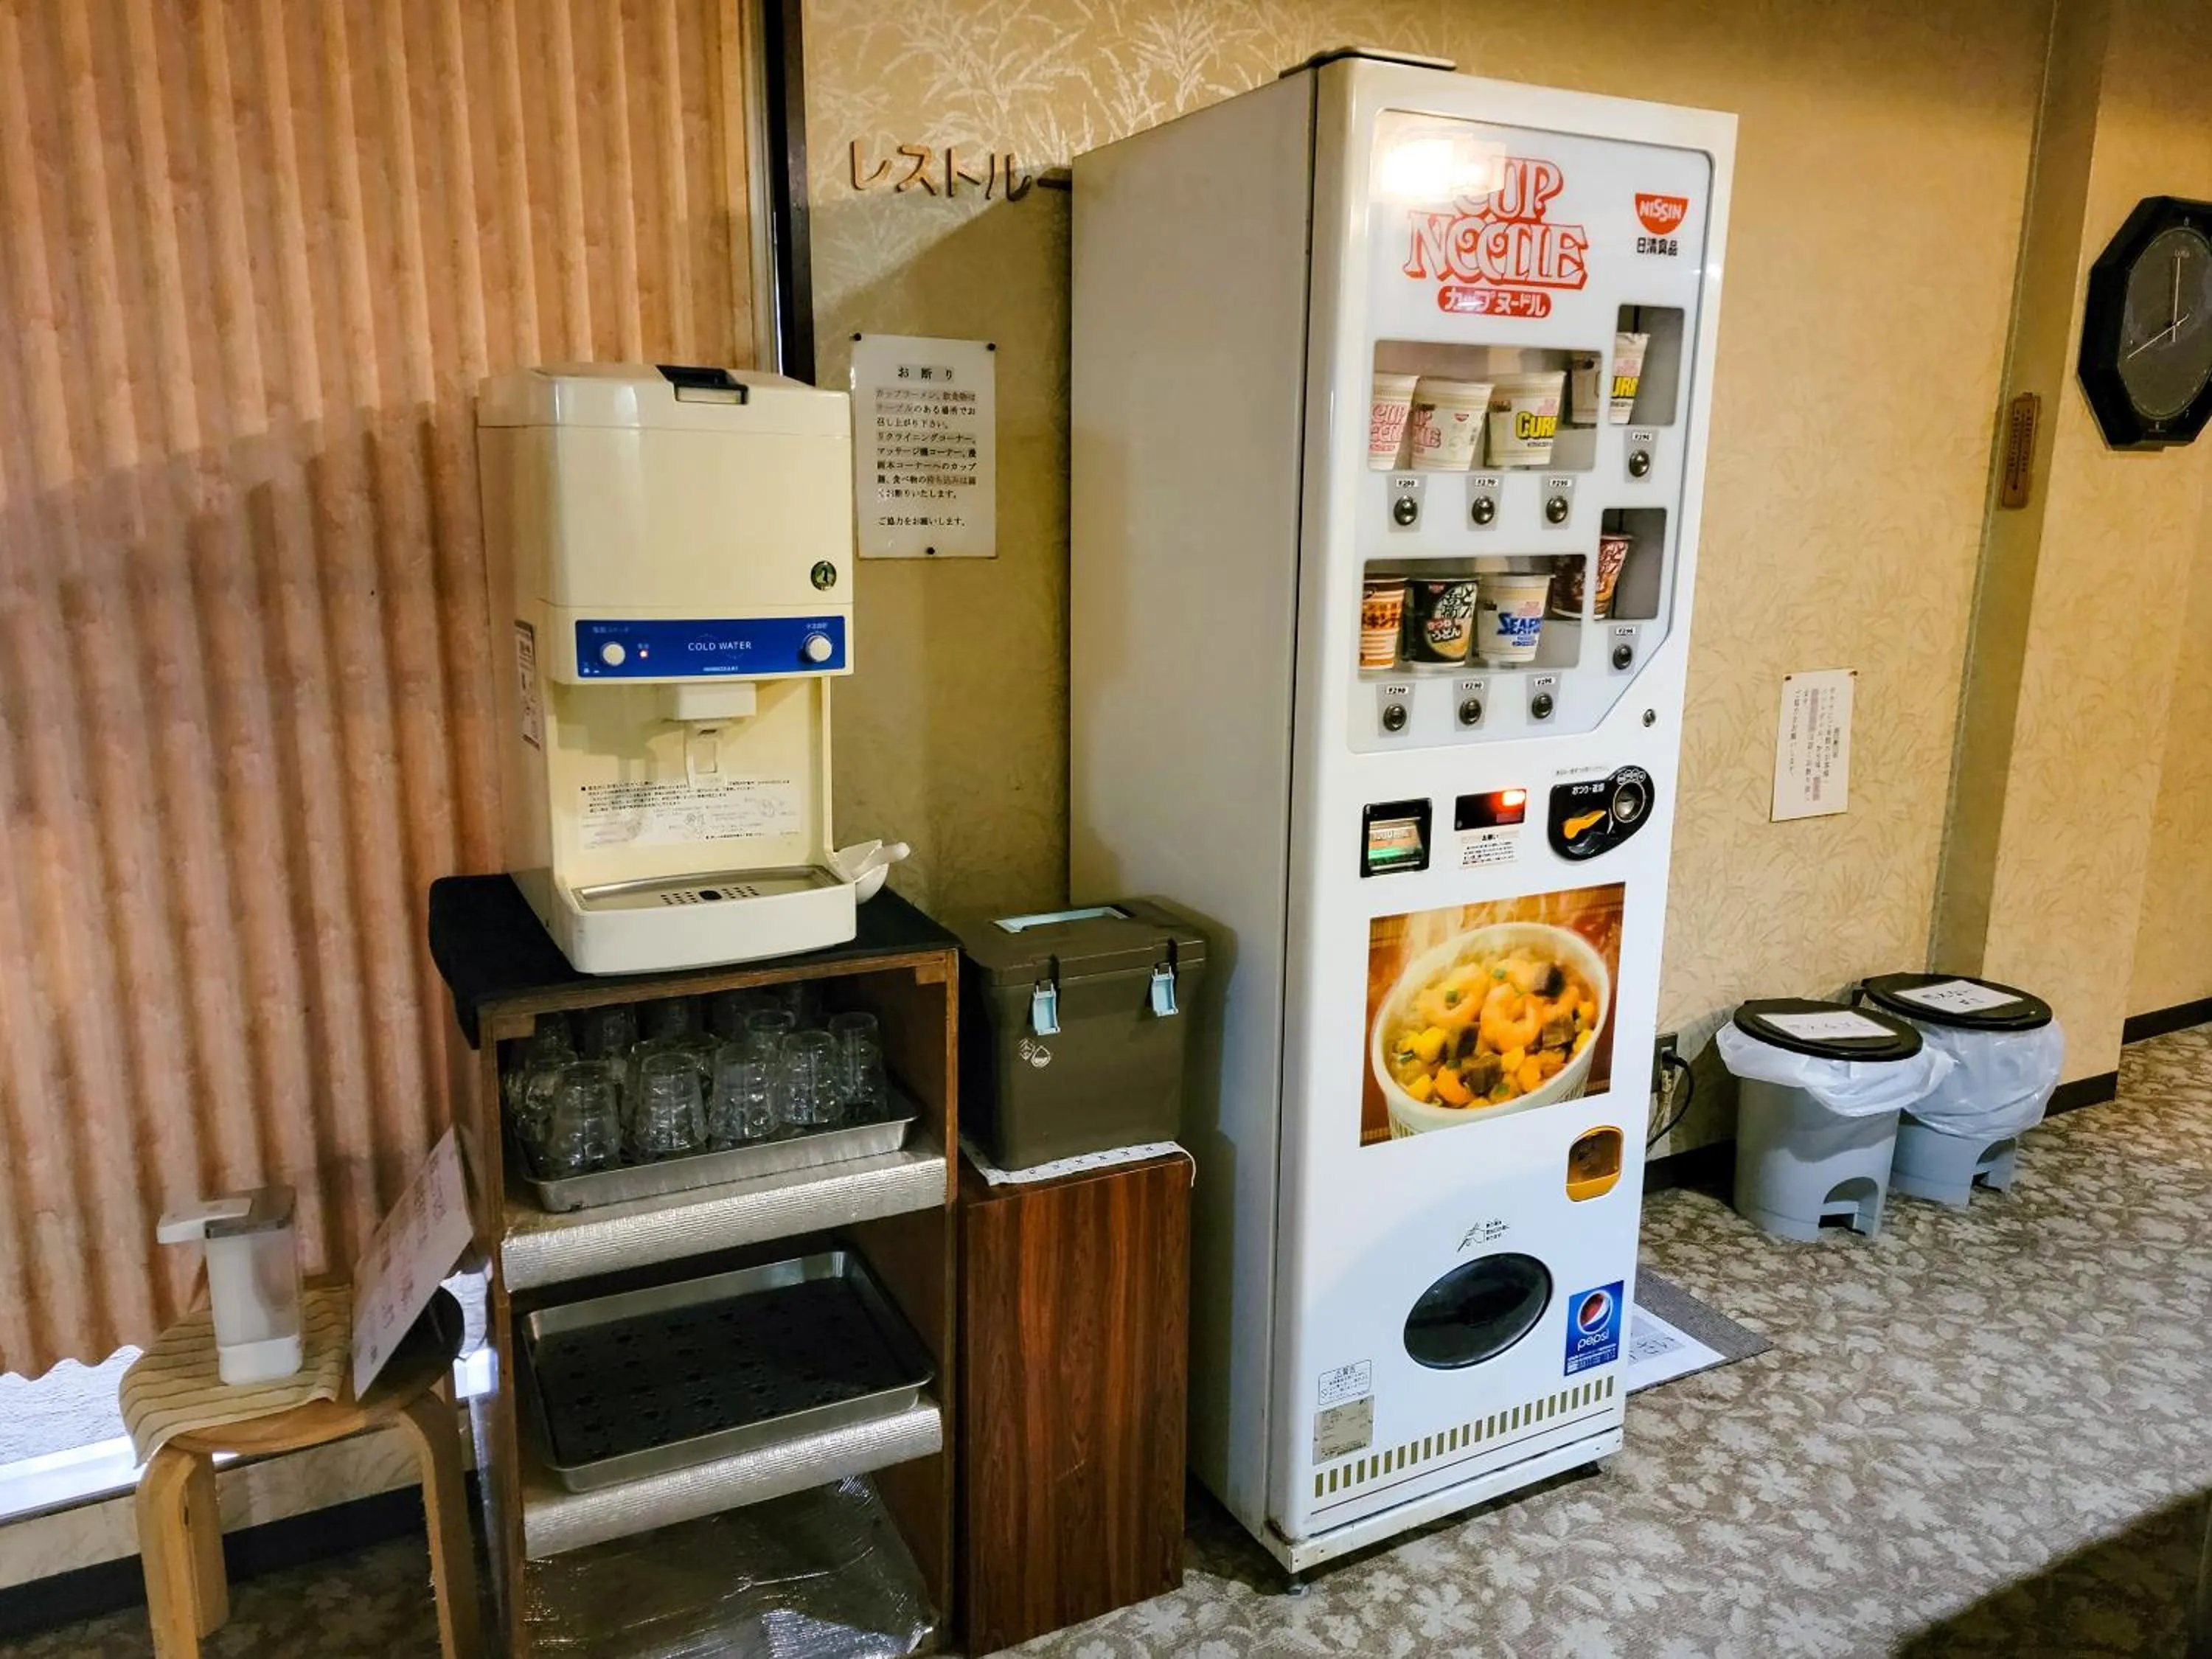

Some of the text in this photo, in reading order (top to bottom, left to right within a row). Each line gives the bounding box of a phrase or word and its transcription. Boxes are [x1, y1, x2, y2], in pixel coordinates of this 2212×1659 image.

[1638, 198, 1683, 223] NISSIN
[1636, 237, 1678, 257] 日清食品
[687, 641, 752, 652] COLD WATER
[1577, 1328, 1610, 1352] pepsi
